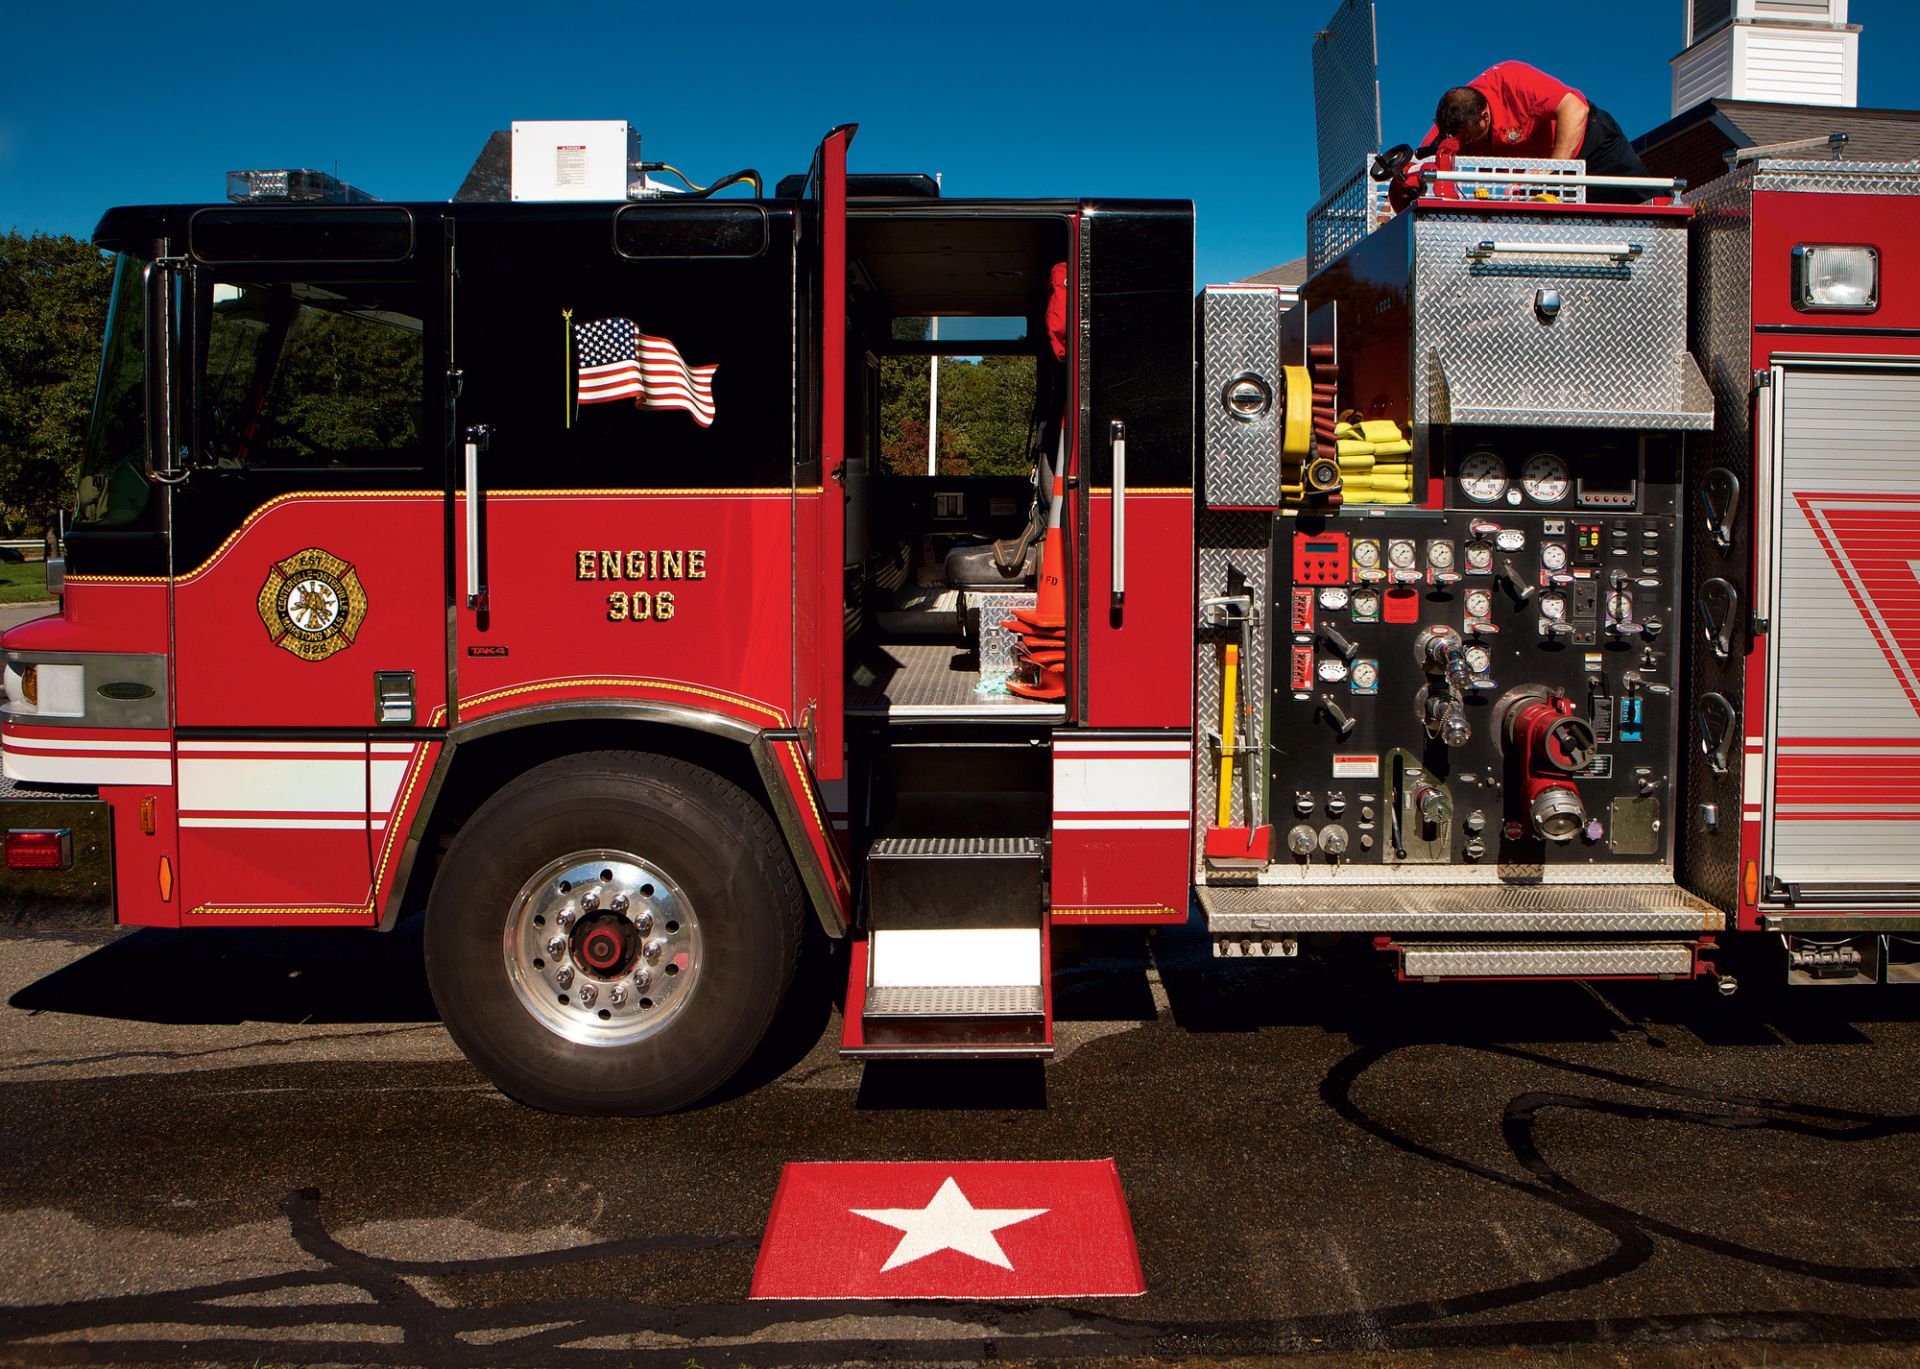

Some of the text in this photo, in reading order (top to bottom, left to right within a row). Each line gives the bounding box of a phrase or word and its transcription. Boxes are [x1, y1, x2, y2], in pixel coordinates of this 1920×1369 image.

[300, 556, 322, 565] EST
[576, 550, 706, 580] ENGINE
[607, 591, 675, 621] 306
[283, 616, 344, 641] MARSTONS MILLS
[300, 644, 328, 654] 1926
